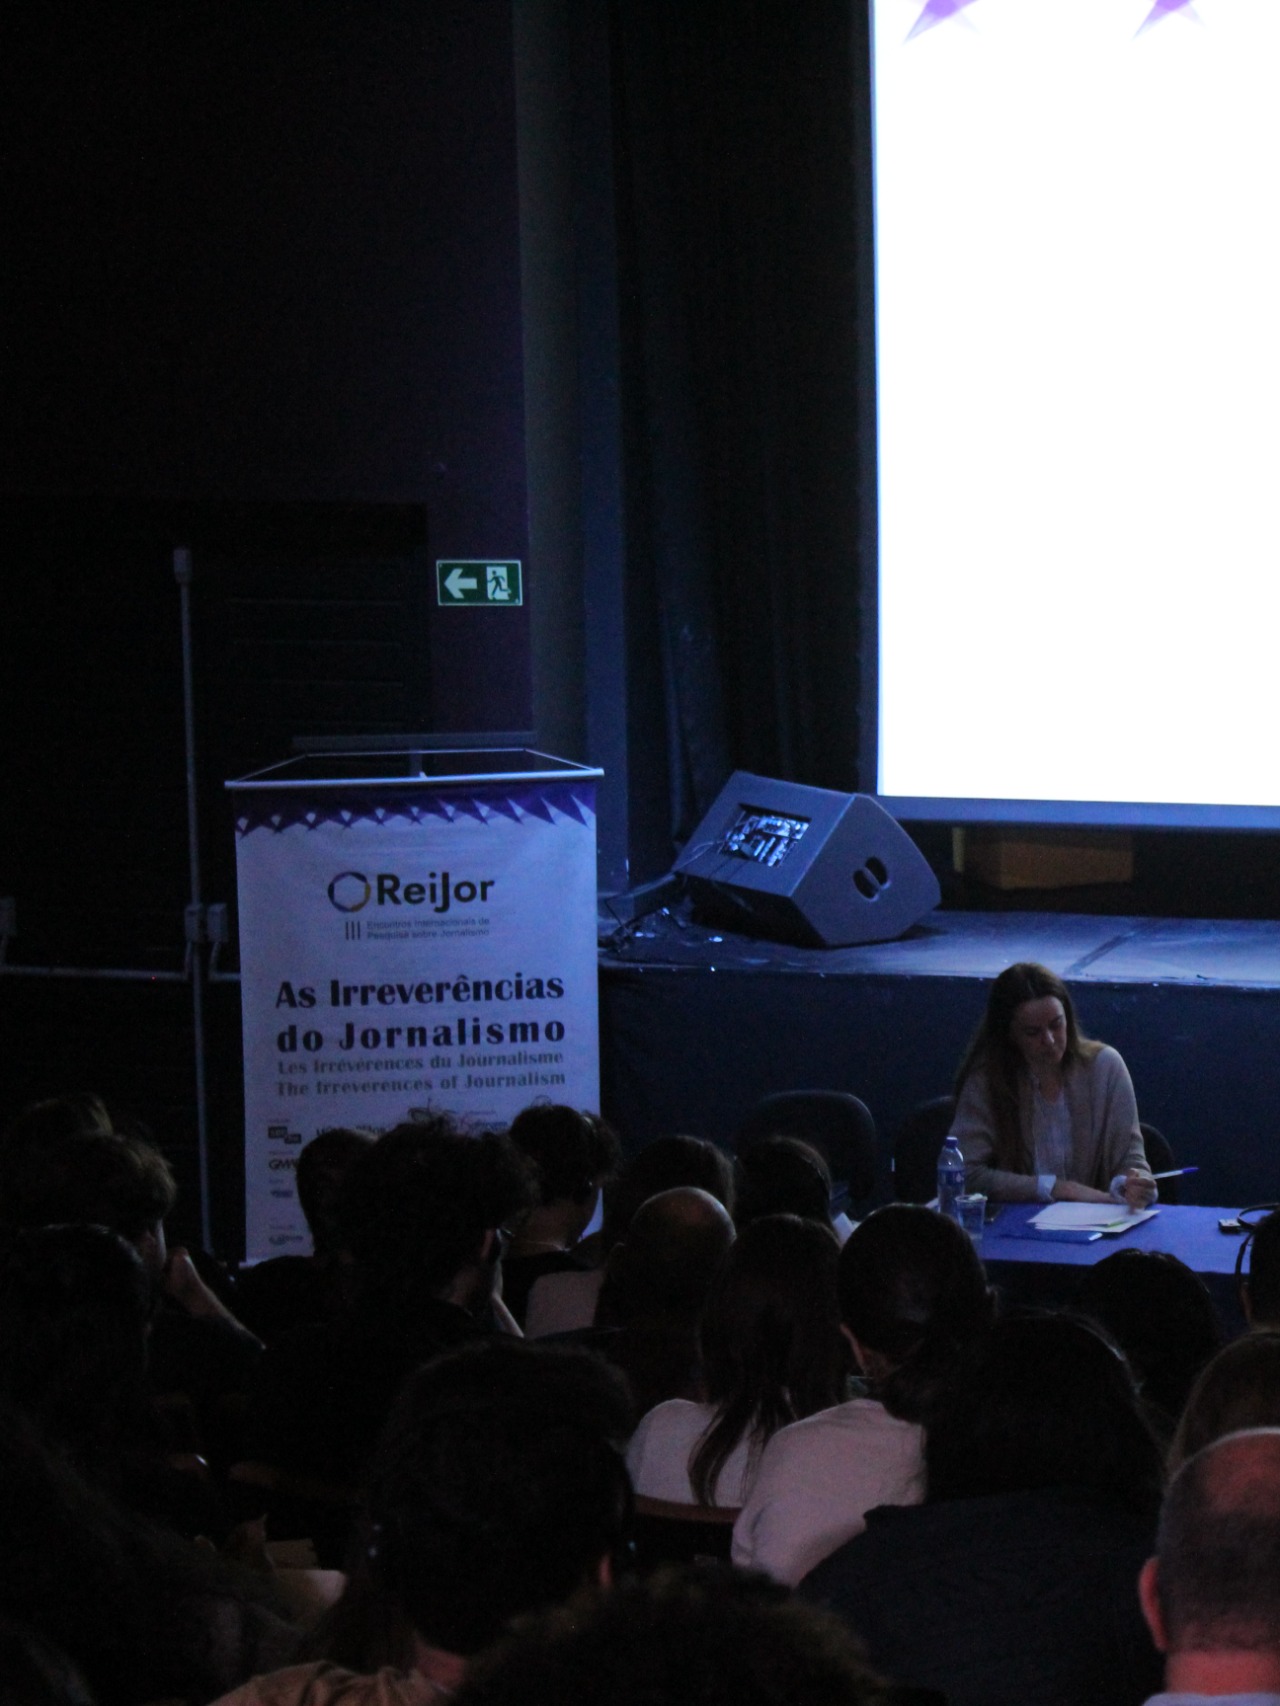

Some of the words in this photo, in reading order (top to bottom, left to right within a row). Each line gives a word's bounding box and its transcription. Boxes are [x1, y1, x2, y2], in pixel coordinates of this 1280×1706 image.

[376, 872, 495, 913] ReiJor
[275, 981, 316, 1009] As
[330, 972, 565, 1008] Irreverências
[276, 1024, 324, 1052] do
[338, 1017, 566, 1050] Jornalismo
[277, 1061, 308, 1075] Les
[430, 1054, 451, 1070] du
[457, 1050, 564, 1068] Journalisme
[277, 1081, 309, 1096] The
[315, 1077, 433, 1095] Irreverences
[440, 1074, 458, 1090] of
[464, 1071, 566, 1089] Journalism
